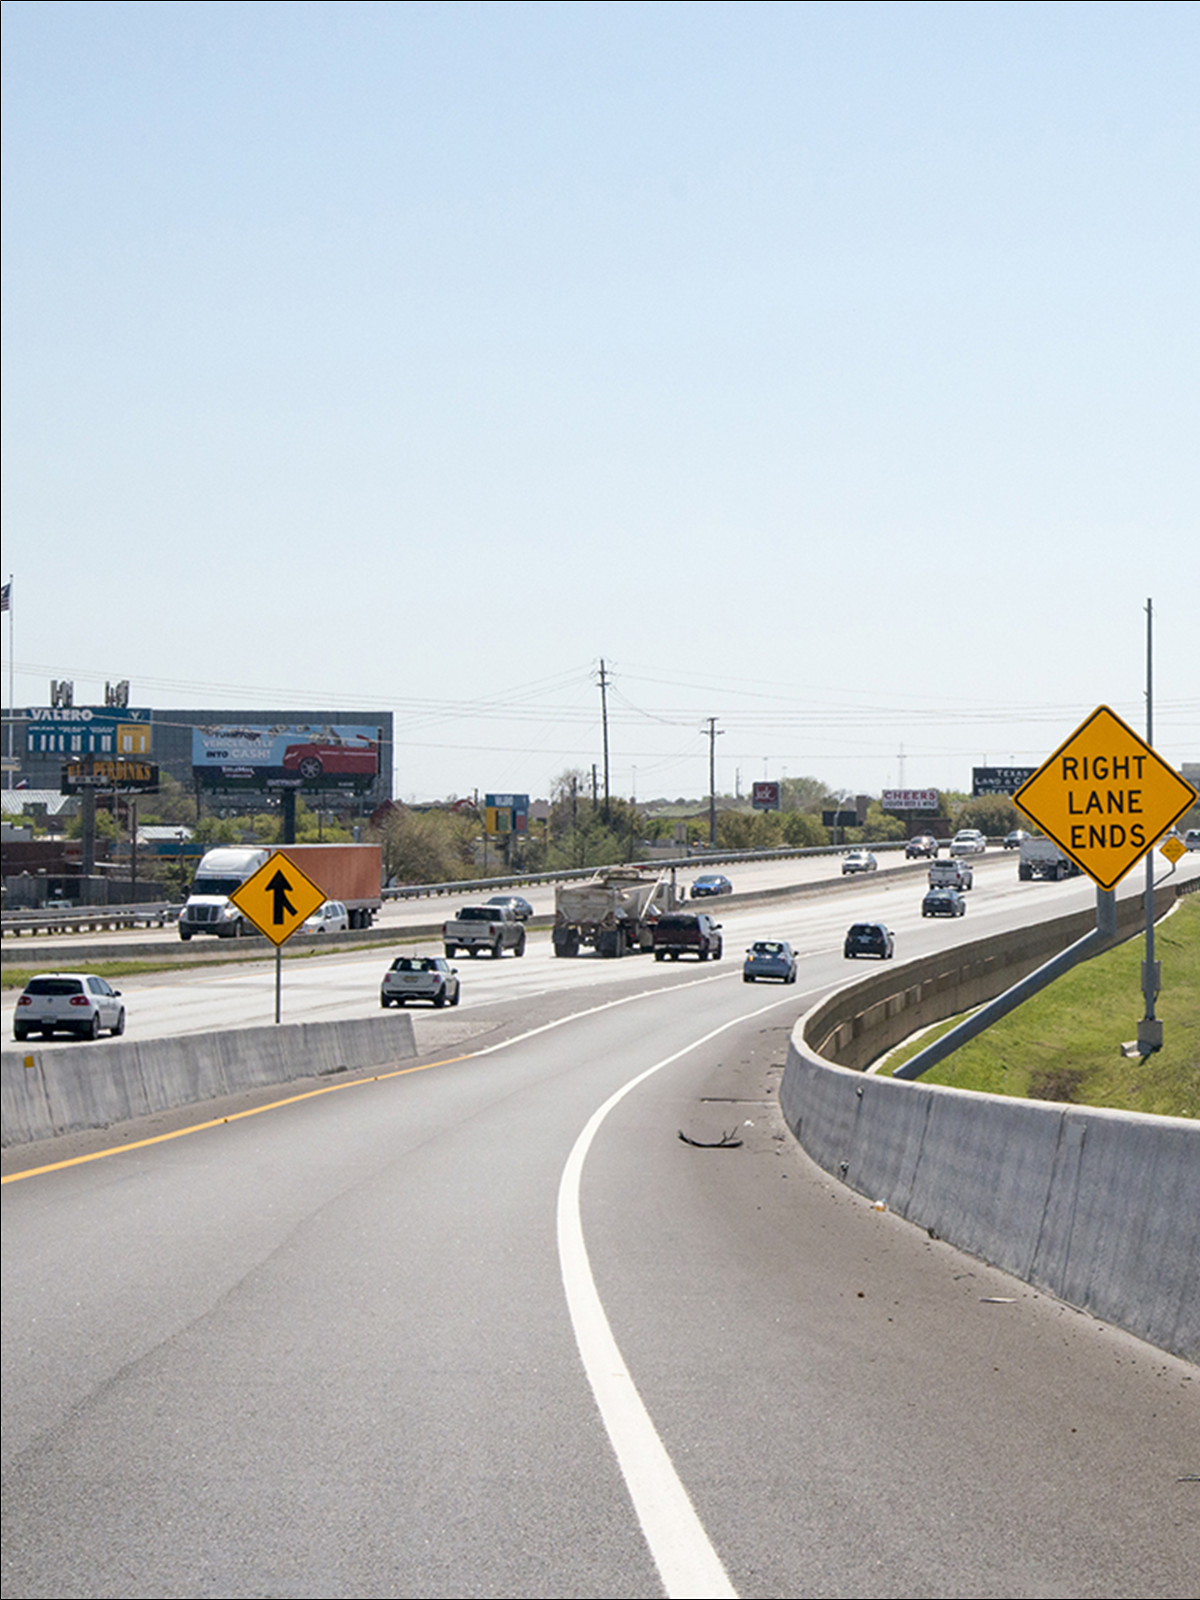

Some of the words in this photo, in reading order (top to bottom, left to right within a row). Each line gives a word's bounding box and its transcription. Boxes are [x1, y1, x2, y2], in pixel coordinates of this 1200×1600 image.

[30, 708, 93, 721] VALERO
[203, 740, 244, 748] VEHICLE
[231, 749, 271, 759] CASH!
[996, 769, 1029, 777] TEXAS
[1062, 756, 1147, 781] RIGHT
[975, 777, 1002, 786] LAND
[884, 791, 937, 800] CHEERS
[1068, 790, 1143, 815] LANE
[1071, 824, 1146, 849] ENDS
